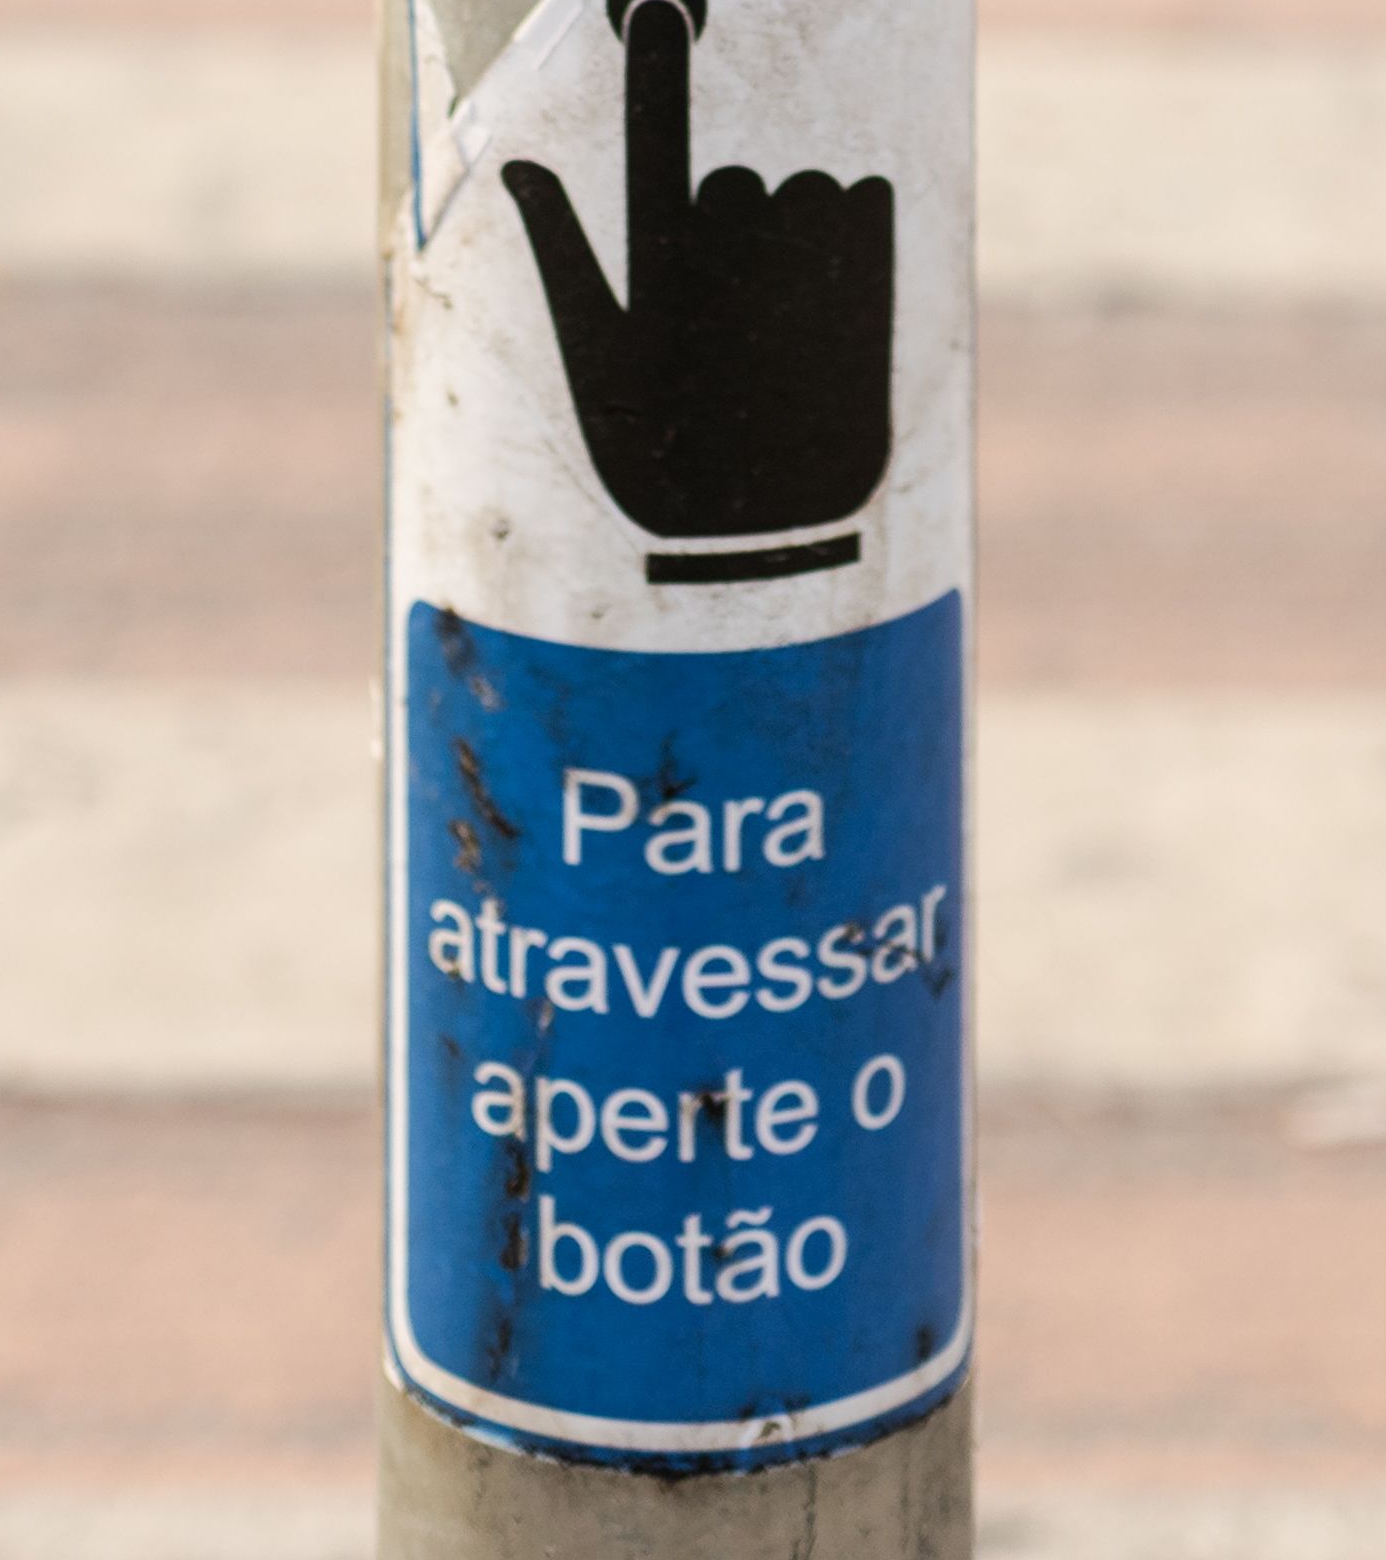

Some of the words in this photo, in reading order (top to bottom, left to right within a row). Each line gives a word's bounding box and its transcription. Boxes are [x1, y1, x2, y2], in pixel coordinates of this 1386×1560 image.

[562, 768, 825, 875] Para
[426, 884, 948, 1020] atravessar
[470, 1058, 820, 1175] aperte
[852, 1053, 907, 1131] o
[537, 1194, 848, 1306] botão
